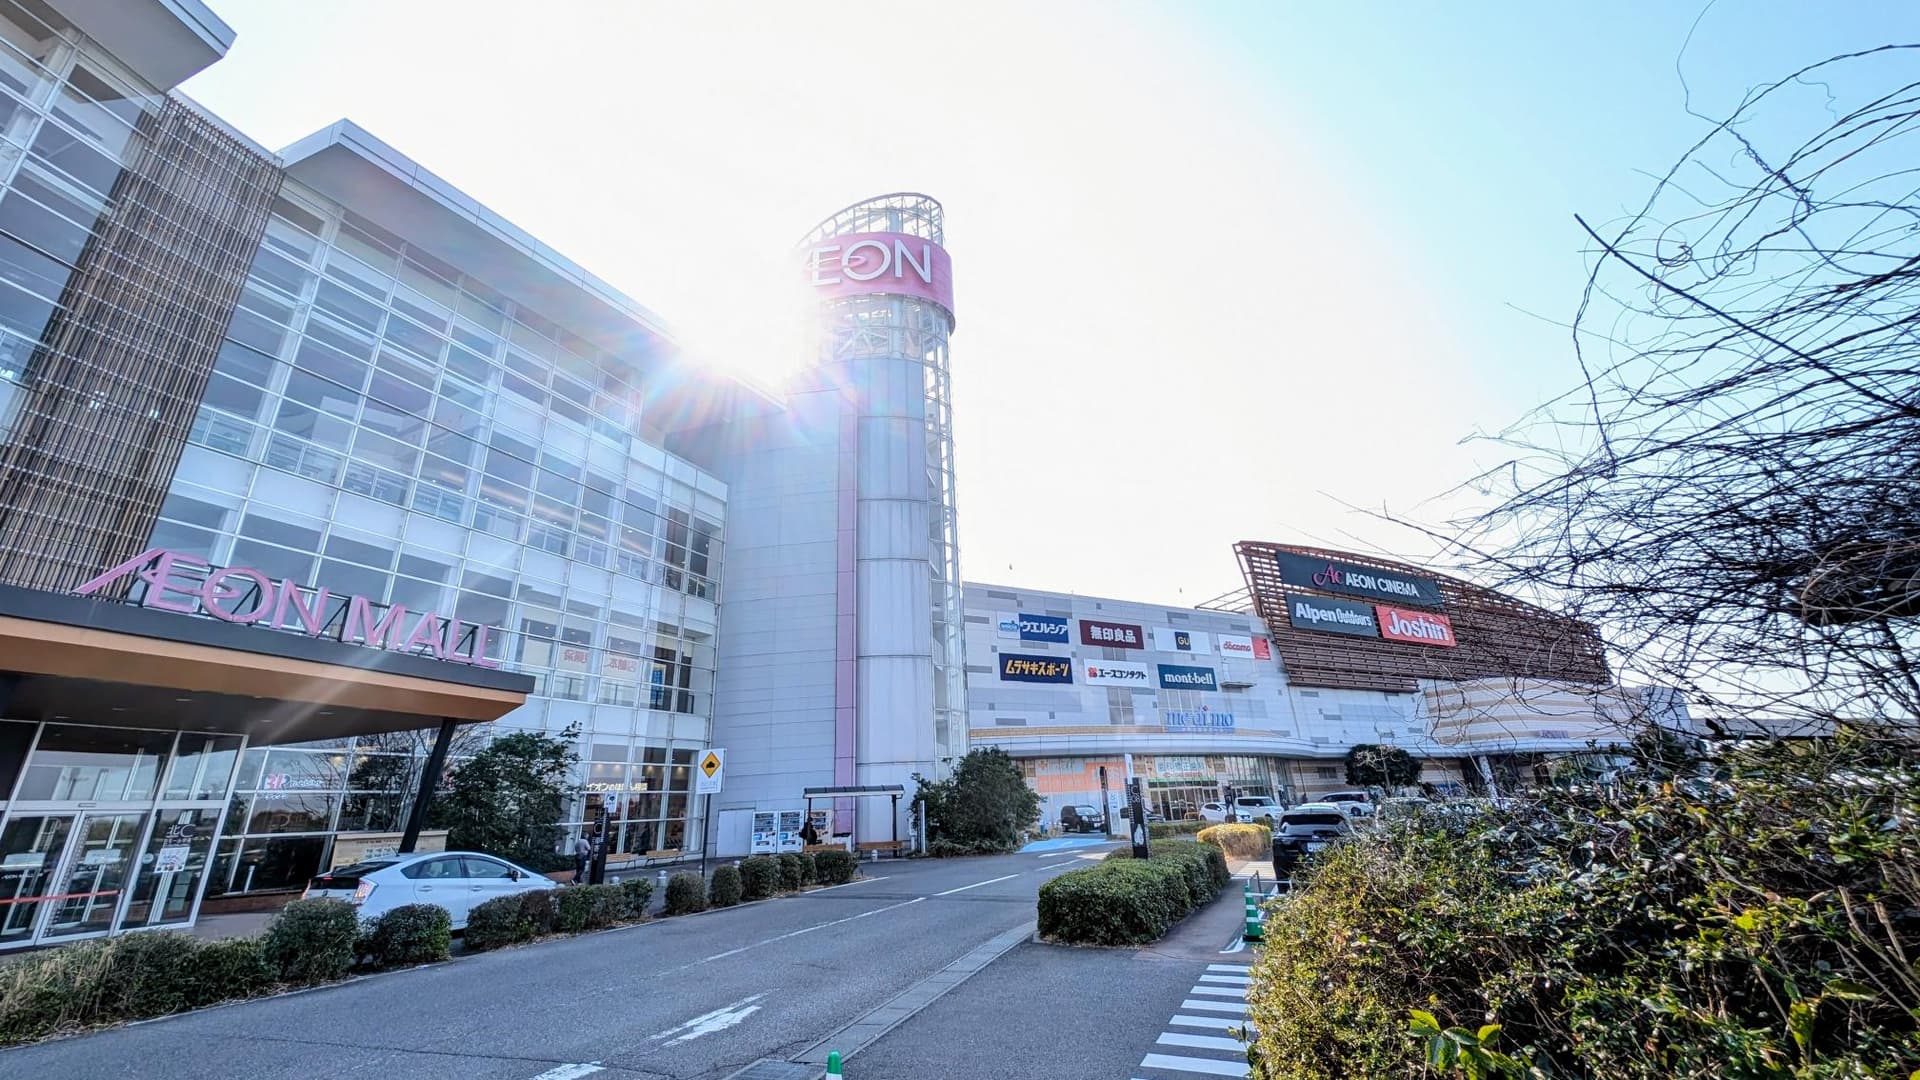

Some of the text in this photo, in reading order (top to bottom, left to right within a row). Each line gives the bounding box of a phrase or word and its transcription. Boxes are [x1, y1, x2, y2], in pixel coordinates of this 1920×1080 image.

[1345, 573, 1377, 590] AEON
[1378, 579, 1420, 598] CINEMA
[1295, 602, 1372, 626] Alpen Outdoors
[342, 594, 499, 669] MALL
[1019, 620, 1068, 635] ウエルシア
[1090, 624, 1136, 643] 無印良品
[1388, 610, 1449, 641] Joshin
[1177, 636, 1190, 646] GU
[1005, 659, 1069, 677] ムラサキスポーツ
[1098, 668, 1146, 680] エースコンタクト
